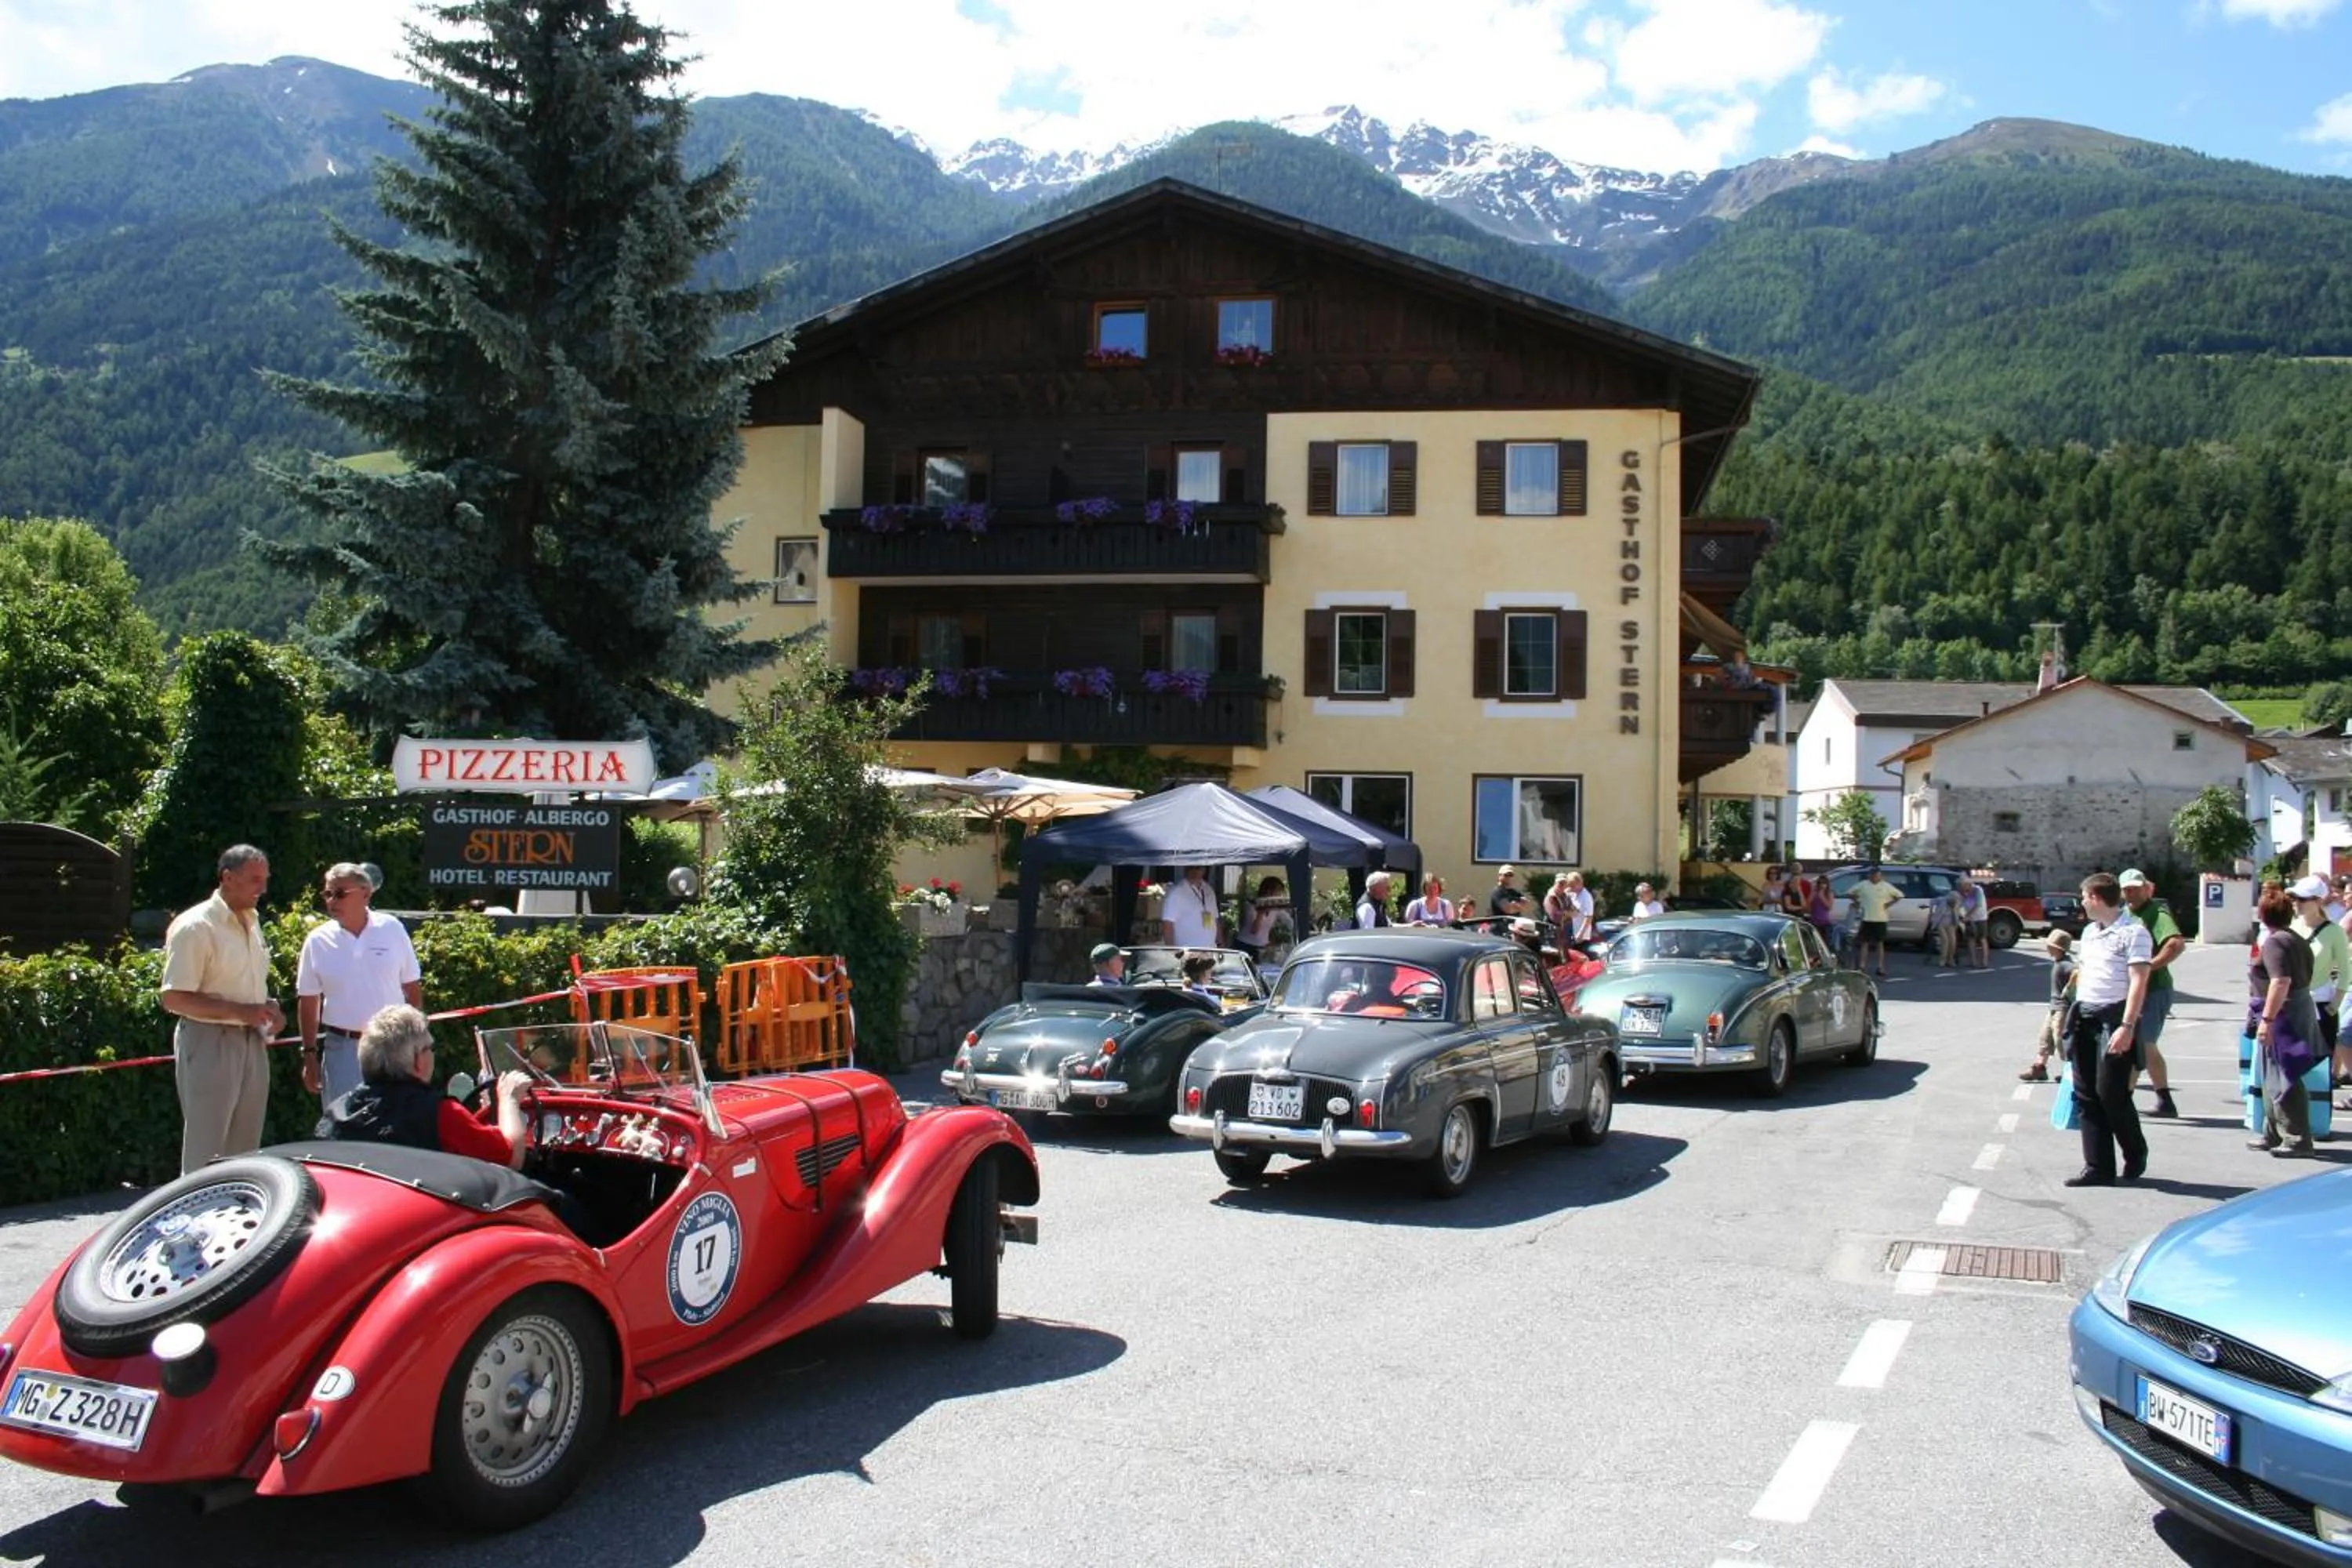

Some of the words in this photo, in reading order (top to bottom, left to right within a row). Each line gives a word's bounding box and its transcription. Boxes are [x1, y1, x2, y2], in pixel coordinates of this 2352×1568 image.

[1620, 450, 1641, 606] GASTHOF
[1620, 621, 1640, 735] STERN
[417, 749, 629, 784] PIZZERIA
[433, 808, 517, 824] GASTHOF
[525, 809, 610, 826] ALBERGO
[464, 828, 575, 864] STERN
[429, 868, 492, 885] HOTEL
[495, 869, 612, 887] RESTAURANT
[2209, 885, 2221, 899] P
[694, 1234, 717, 1275] 17
[19, 1381, 45, 1416] MG
[319, 1372, 341, 1395] D
[2169, 1401, 2213, 1447] 571TE
